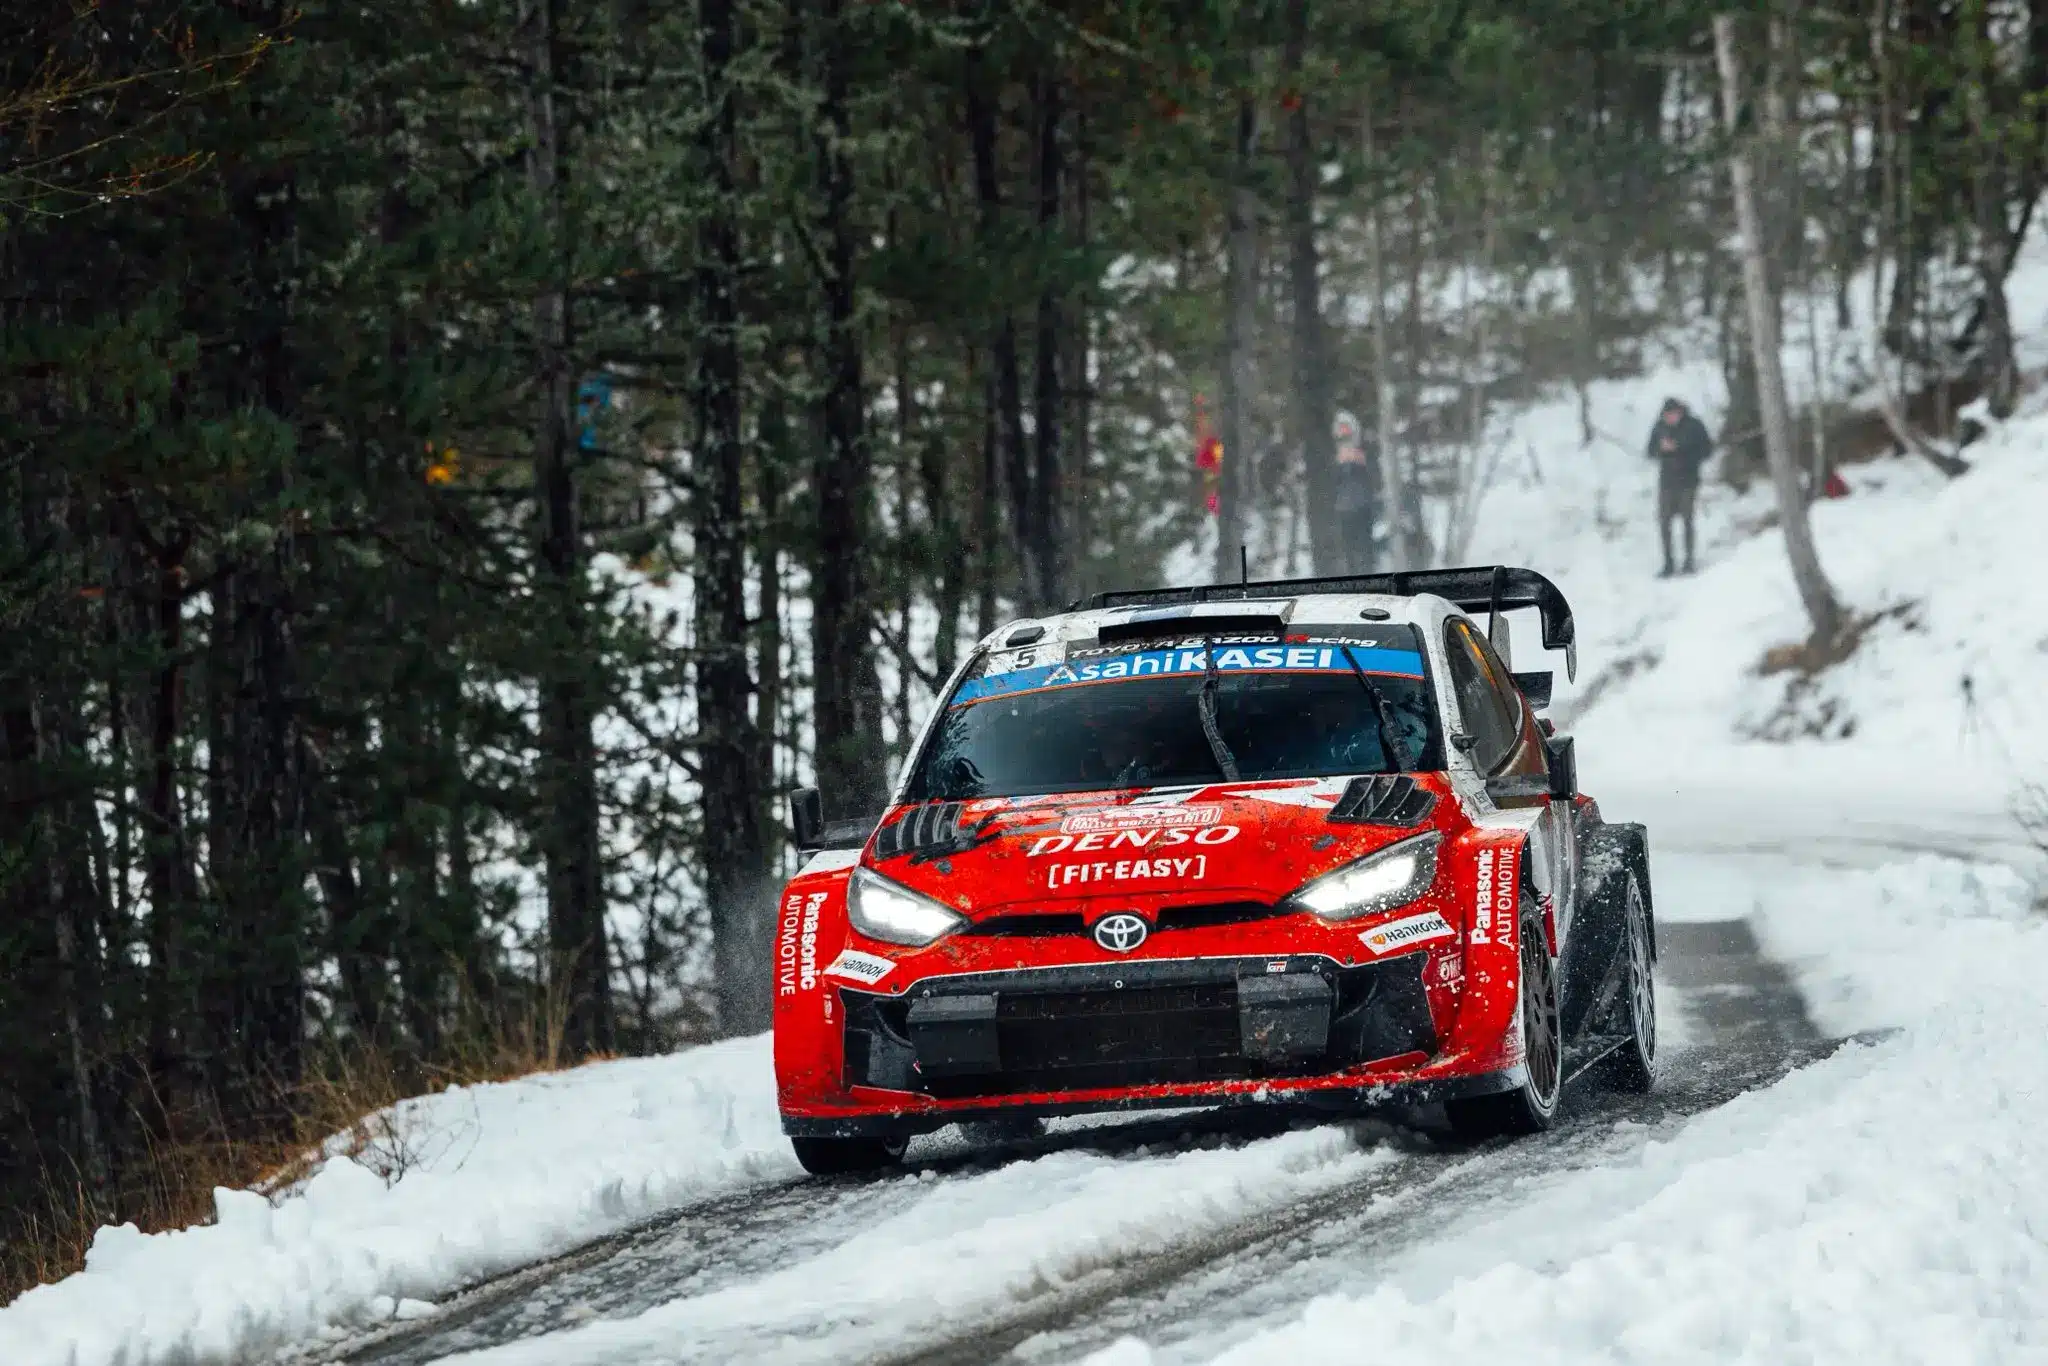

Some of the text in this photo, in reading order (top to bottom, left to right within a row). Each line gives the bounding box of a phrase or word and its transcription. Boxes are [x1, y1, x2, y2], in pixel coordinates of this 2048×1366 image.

[1014, 648, 1037, 669] 5
[1026, 826, 1241, 857] DENSO
[780, 894, 803, 997] AUTOMOTIVE
[800, 891, 828, 990] Panasonic
[1470, 848, 1494, 945] Panasonic
[1496, 847, 1516, 951] AUTOMOTIVE
